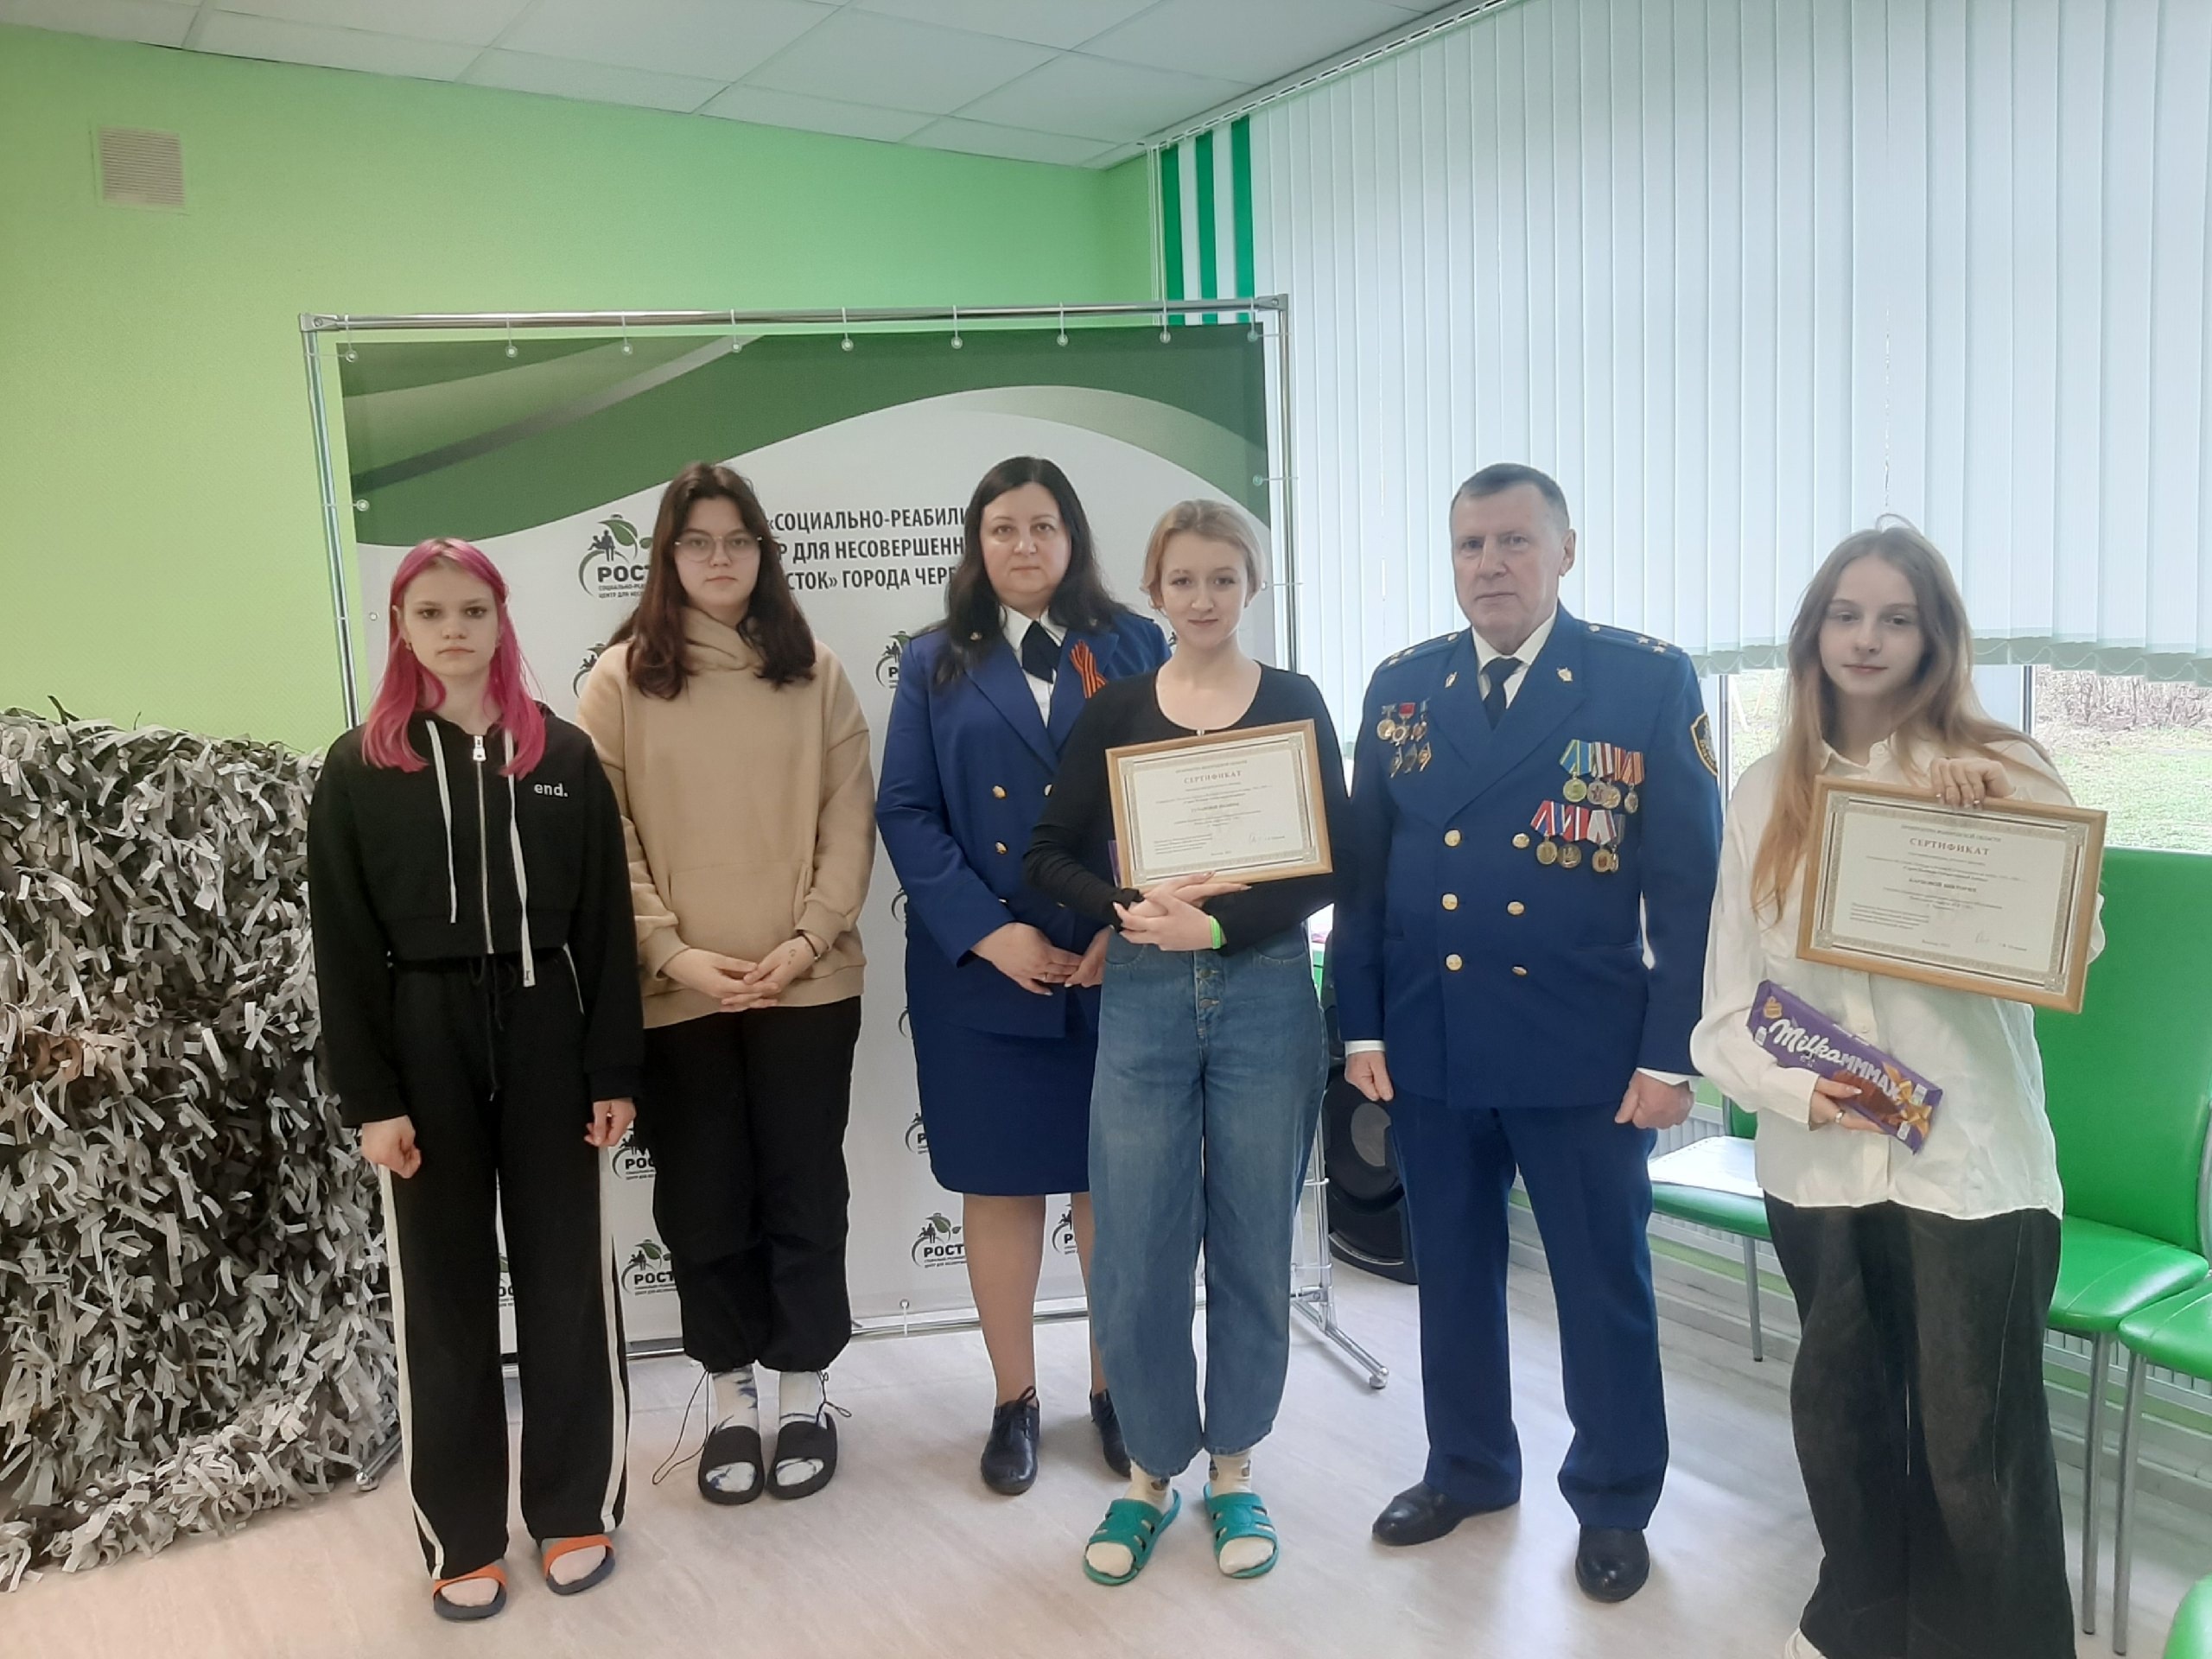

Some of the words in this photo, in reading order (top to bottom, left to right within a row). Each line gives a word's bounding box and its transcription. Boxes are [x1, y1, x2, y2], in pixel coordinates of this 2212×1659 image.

[793, 542, 830, 563] ДЛЯ
[835, 537, 964, 559] НЕСОВЕРШЕНН
[597, 564, 651, 582] РОС
[842, 568, 911, 590] ГОРОДА
[534, 783, 569, 797] end.
[1910, 837, 1990, 855] СЕРТИФИКАТ
[924, 1243, 965, 1257] РОСТ
